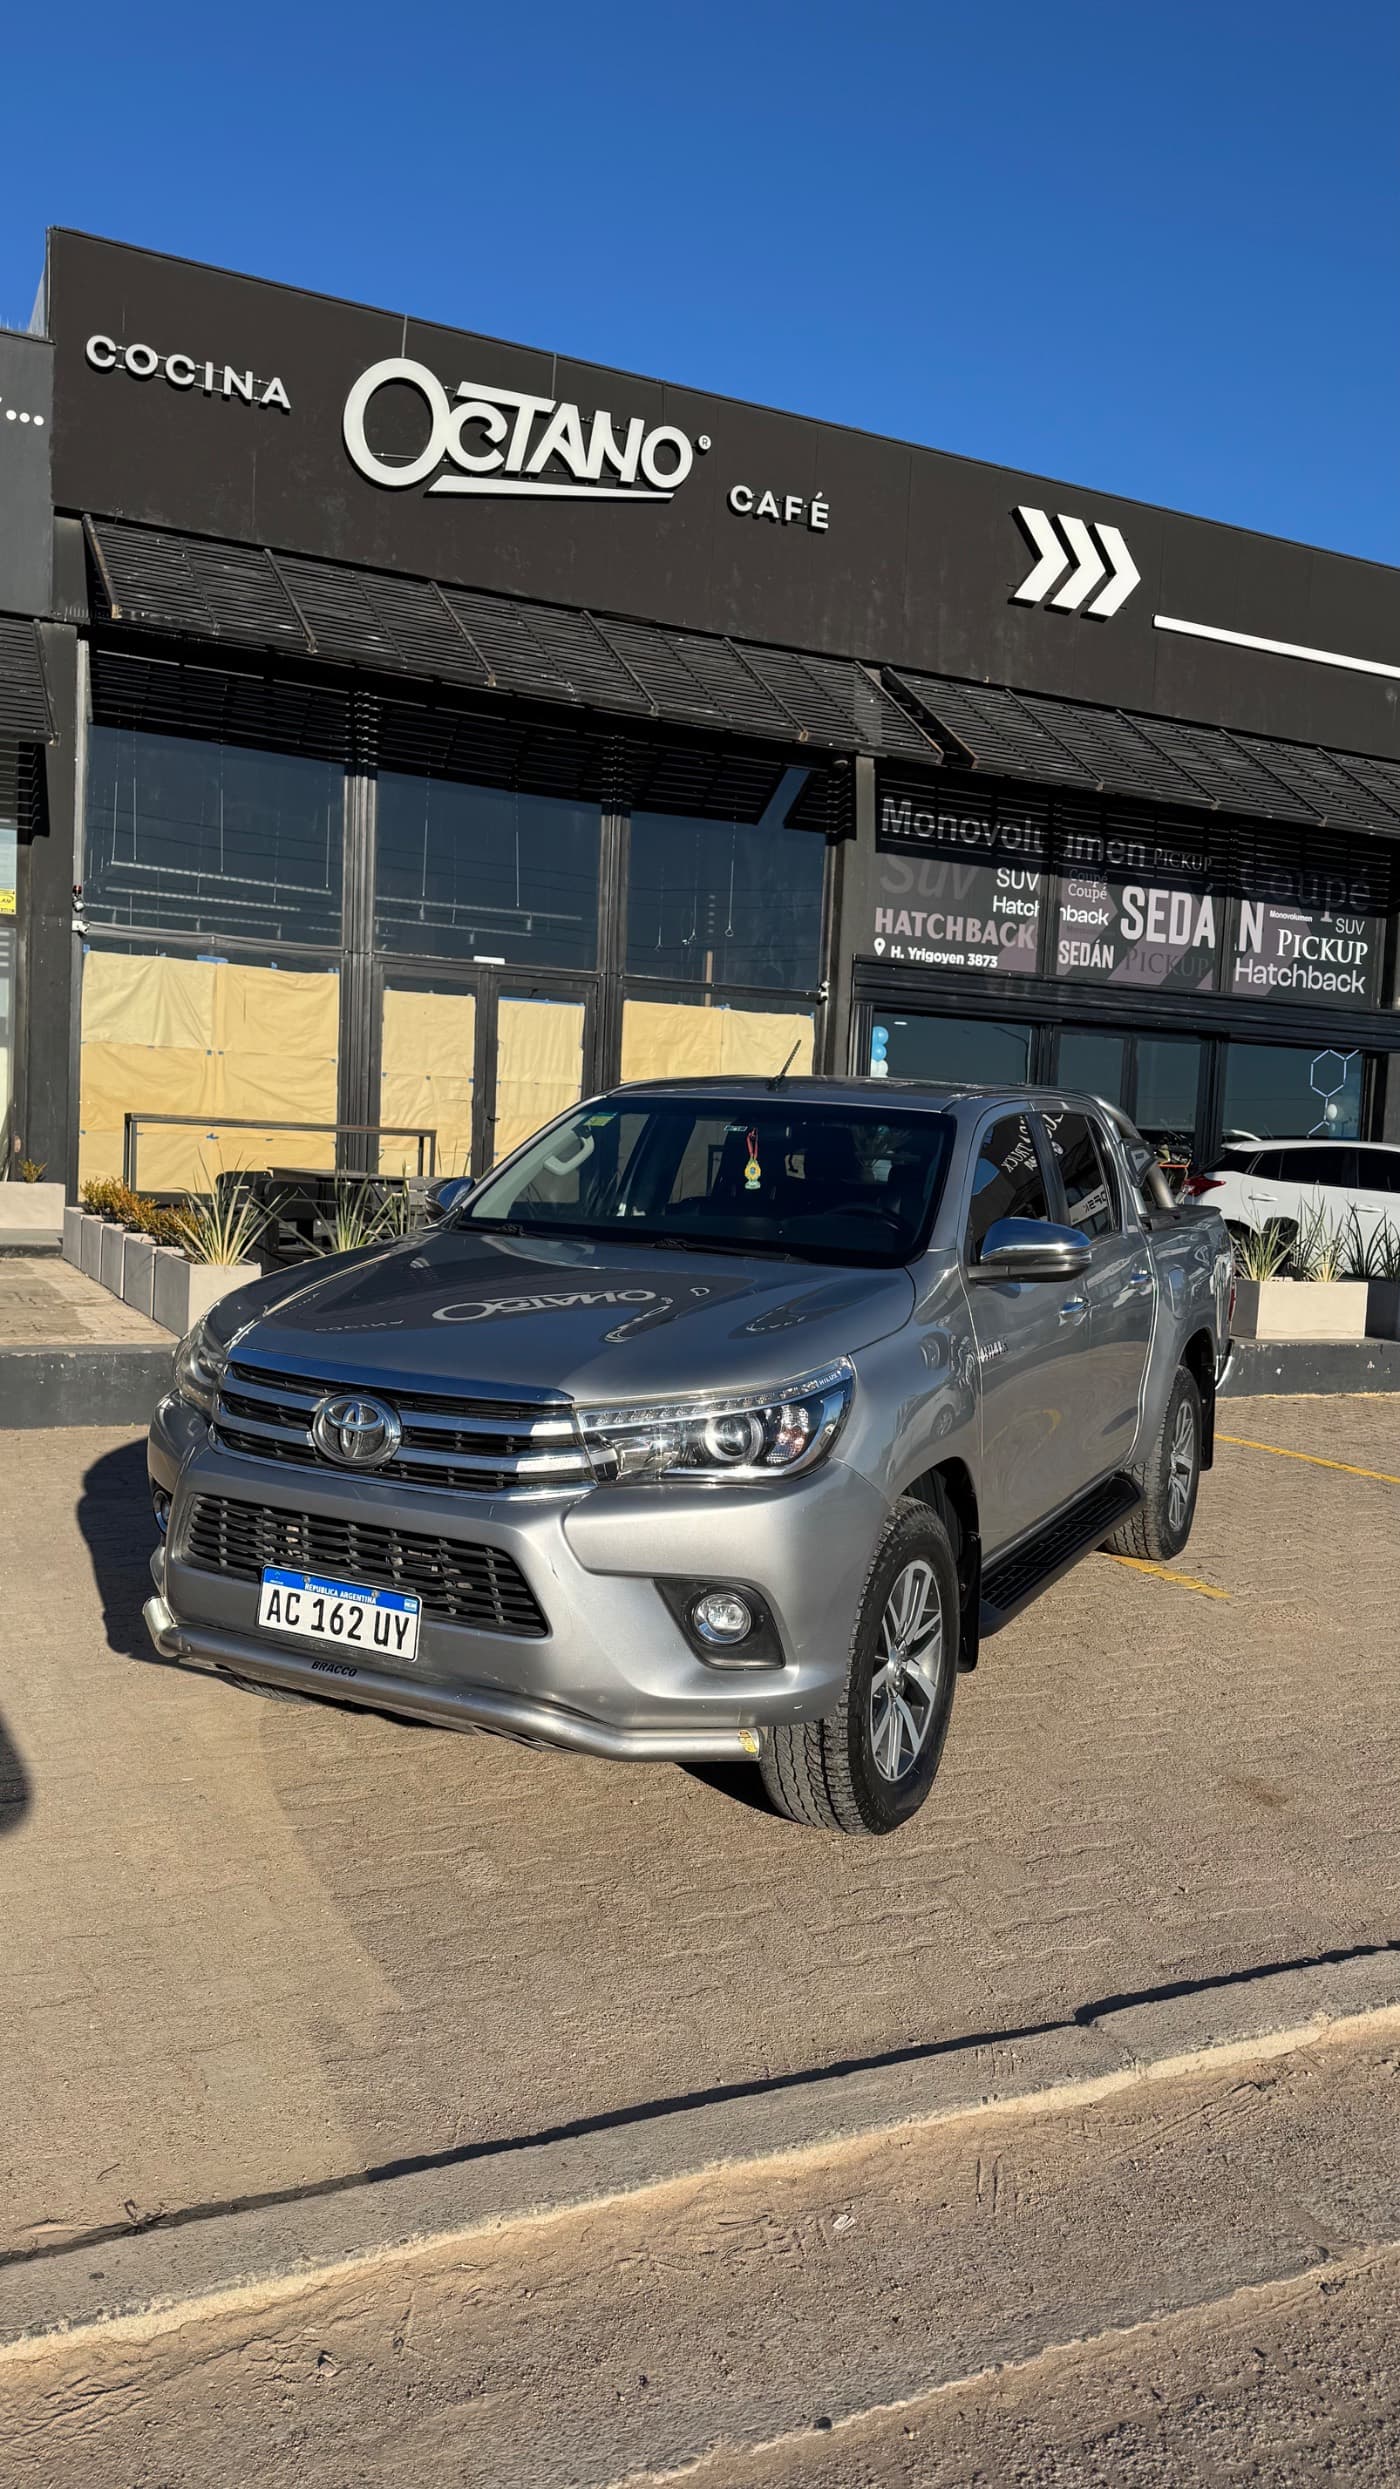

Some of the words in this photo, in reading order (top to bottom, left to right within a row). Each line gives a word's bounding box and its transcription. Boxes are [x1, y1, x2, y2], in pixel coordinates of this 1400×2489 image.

[85, 333, 292, 411] COCINA
[343, 356, 694, 490] OCTANO
[728, 485, 831, 530] CAFÉ
[1153, 846, 1213, 873] PICKUP
[996, 866, 1040, 891] SUV
[1068, 882, 1108, 903] Coupé
[874, 907, 1037, 950] HATCHBACK
[1269, 909, 1314, 923] Monovolumen
[1335, 917, 1366, 936] SUV
[890, 945, 905, 960] H.
[907, 947, 965, 965] Yrigoyen
[967, 953, 999, 969] 3873
[1058, 938, 1115, 969] SEDÁN
[1276, 928, 1369, 965] PICKUP
[1125, 948, 1211, 978] PICKUP
[1234, 956, 1367, 995] Hatchback
[340, 1591, 377, 1605] ARGENTINA
[266, 1588, 301, 1626] AC
[310, 1598, 364, 1641] 162
[373, 1610, 410, 1651] UY
[311, 1659, 358, 1678] BRACCO
